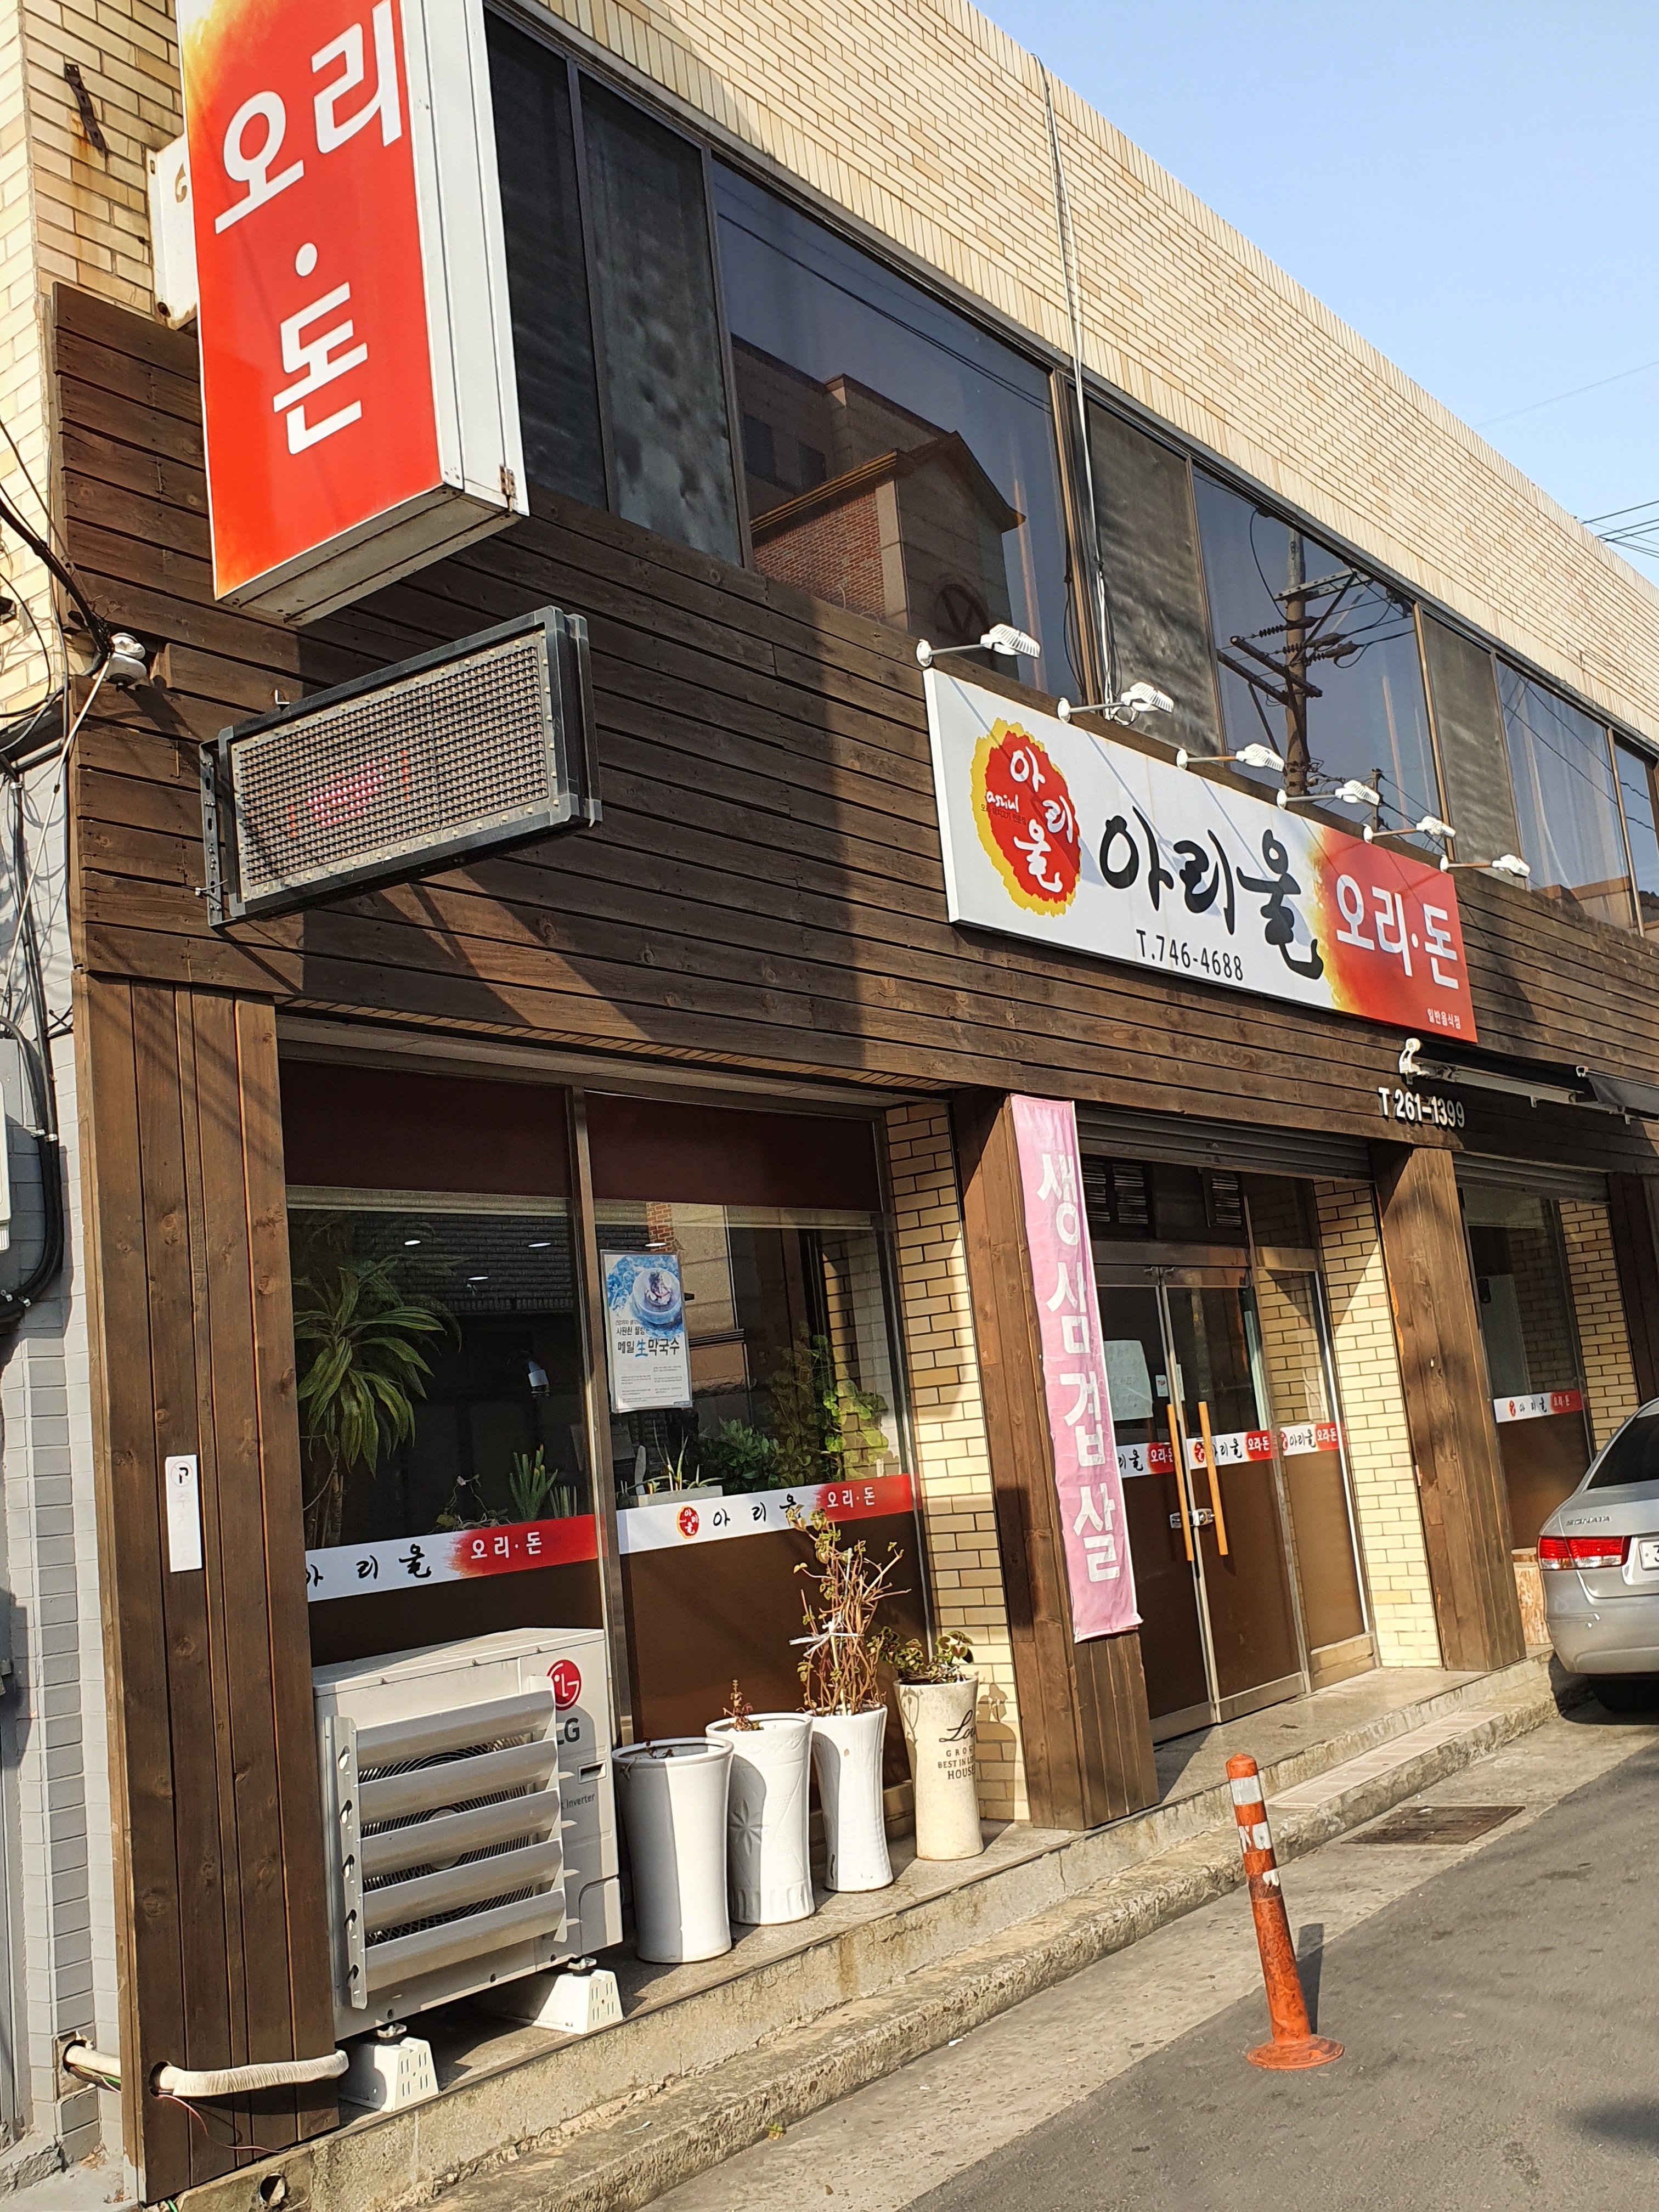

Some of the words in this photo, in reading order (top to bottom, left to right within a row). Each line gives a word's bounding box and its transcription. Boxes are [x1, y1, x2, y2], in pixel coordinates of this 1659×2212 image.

[1099, 805, 1324, 980] 아리울
[1136, 929, 1244, 981] T.746-4688
[1427, 1008, 1462, 1030] 일반음식점
[1394, 1088, 1465, 1128] 261-1399
[1036, 1153, 1120, 1582] 생삼겹살
[1289, 1428, 1316, 1448] 아리울
[1118, 1448, 1144, 1471] 리울
[1566, 1516, 1611, 1526] SONATA
[556, 1717, 580, 1745] G
[938, 1759, 957, 1769] BEST
[959, 1758, 966, 1767] IN
[566, 1793, 595, 1808] Inverter
